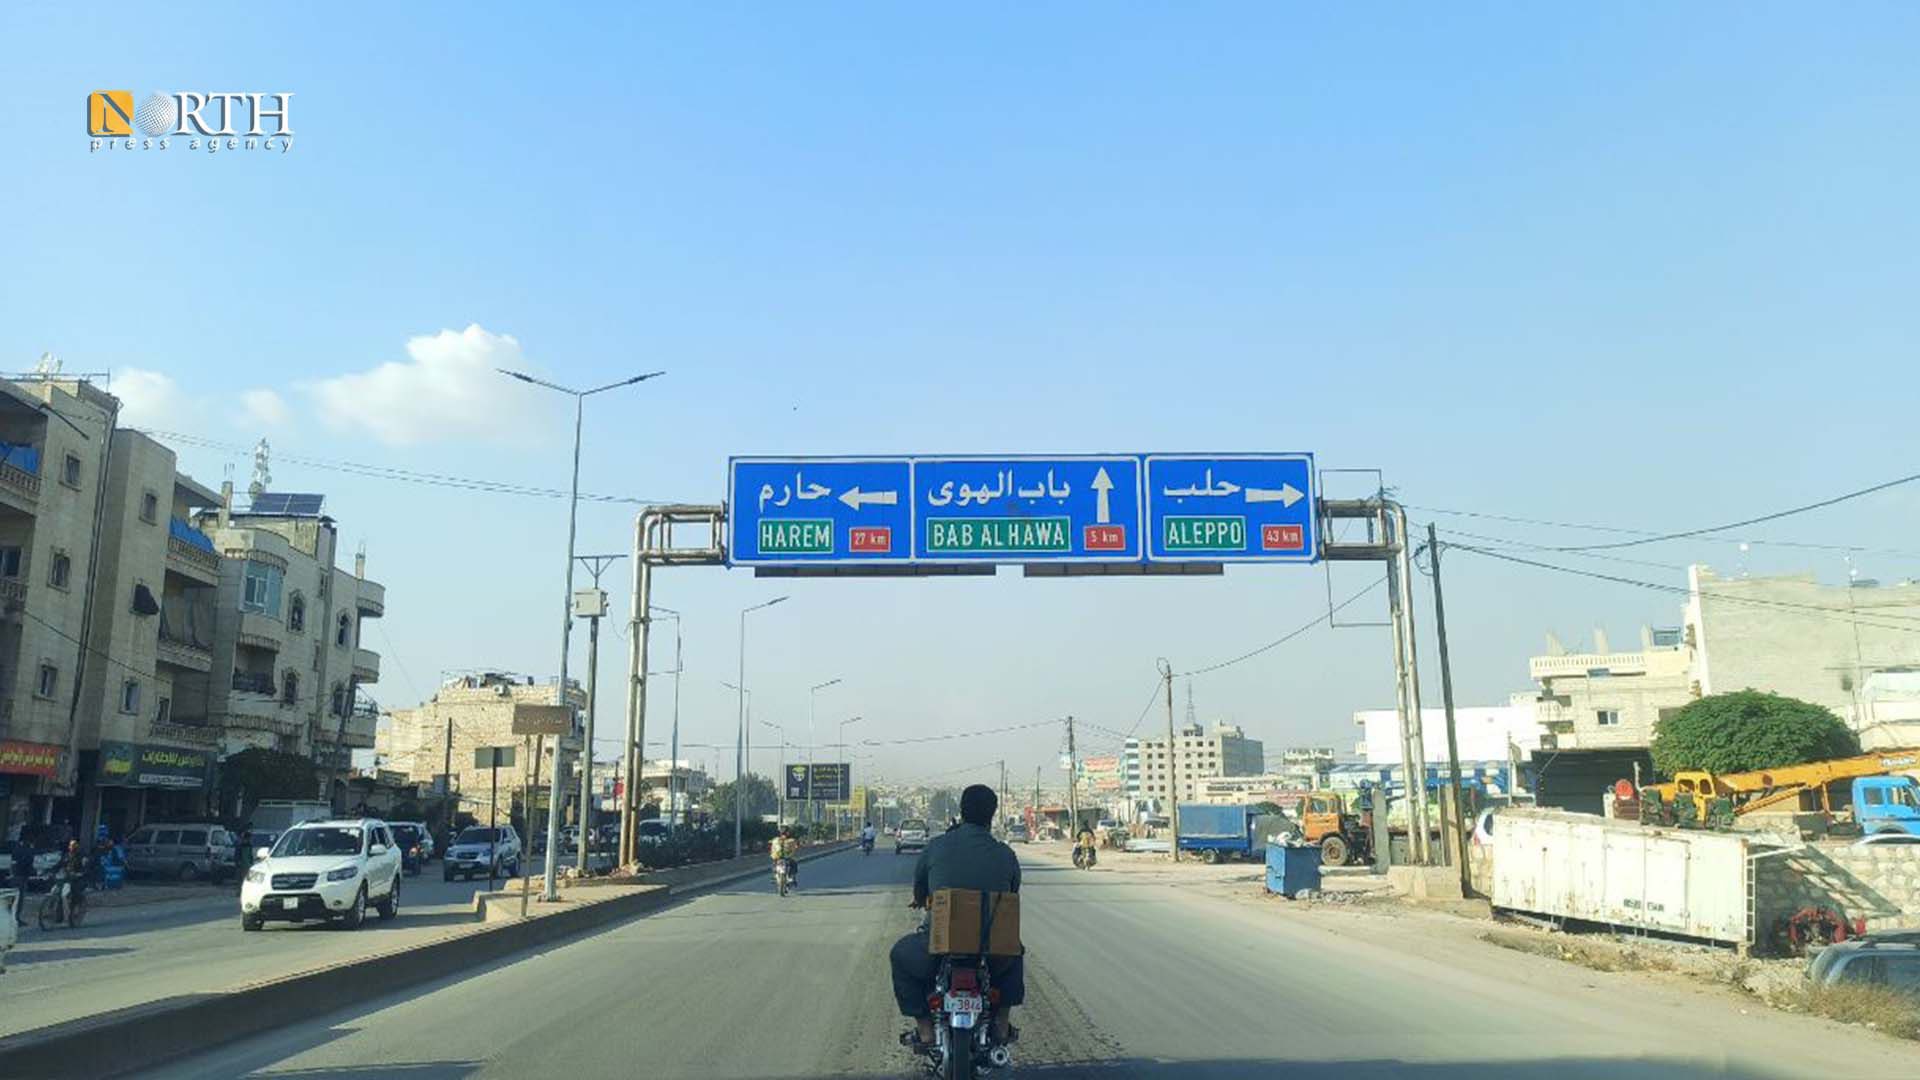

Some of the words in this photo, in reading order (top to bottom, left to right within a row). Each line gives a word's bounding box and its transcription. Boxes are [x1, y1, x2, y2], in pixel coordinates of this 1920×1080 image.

[759, 472, 831, 514] حارم
[928, 469, 1013, 506] الهوى
[1018, 467, 1070, 504] باب
[1164, 468, 1241, 503] حلب
[762, 523, 830, 547] HAREM
[854, 532, 866, 545] 27
[870, 532, 886, 545] km
[934, 524, 973, 547] BAB
[981, 524, 1003, 546] AL
[1008, 523, 1065, 546] HAWA
[1090, 530, 1097, 543] 5
[1102, 530, 1119, 543] km
[1168, 522, 1242, 545] ALEPPO
[1266, 529, 1279, 543] 43
[1282, 529, 1299, 543] km
